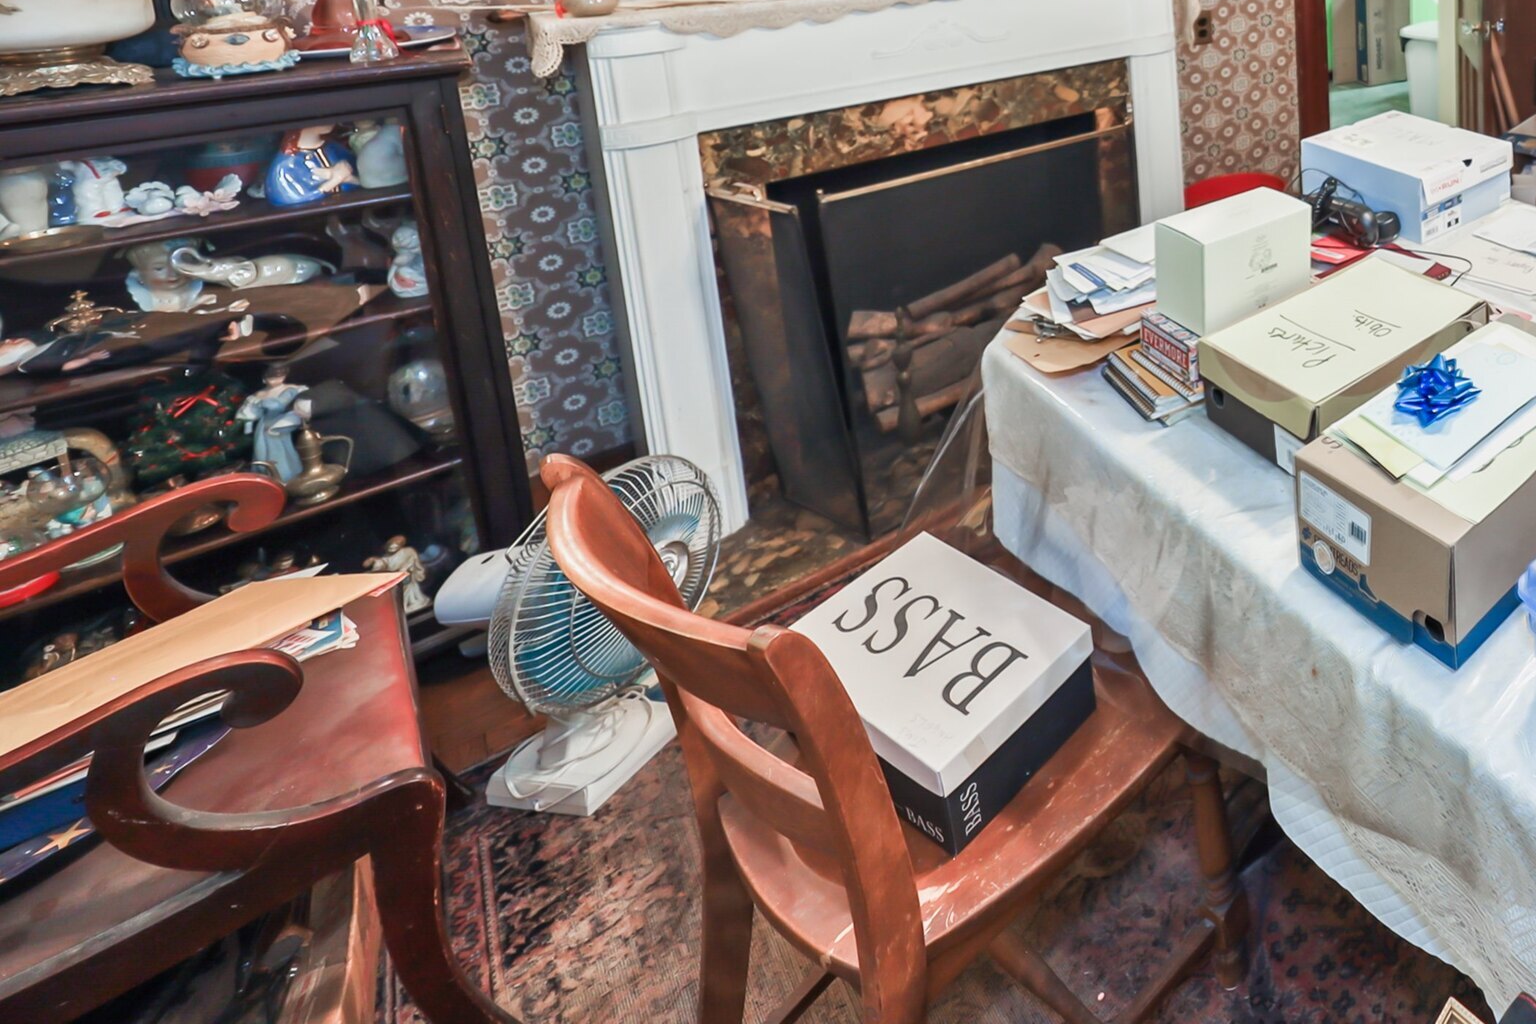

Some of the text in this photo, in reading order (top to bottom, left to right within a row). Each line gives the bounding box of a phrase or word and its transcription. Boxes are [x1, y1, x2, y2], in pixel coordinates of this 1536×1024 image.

[1313, 533, 1361, 576] FTREADS
[832, 576, 1029, 716] BASS
[905, 806, 945, 844] BASS
[959, 781, 979, 837] BASS
